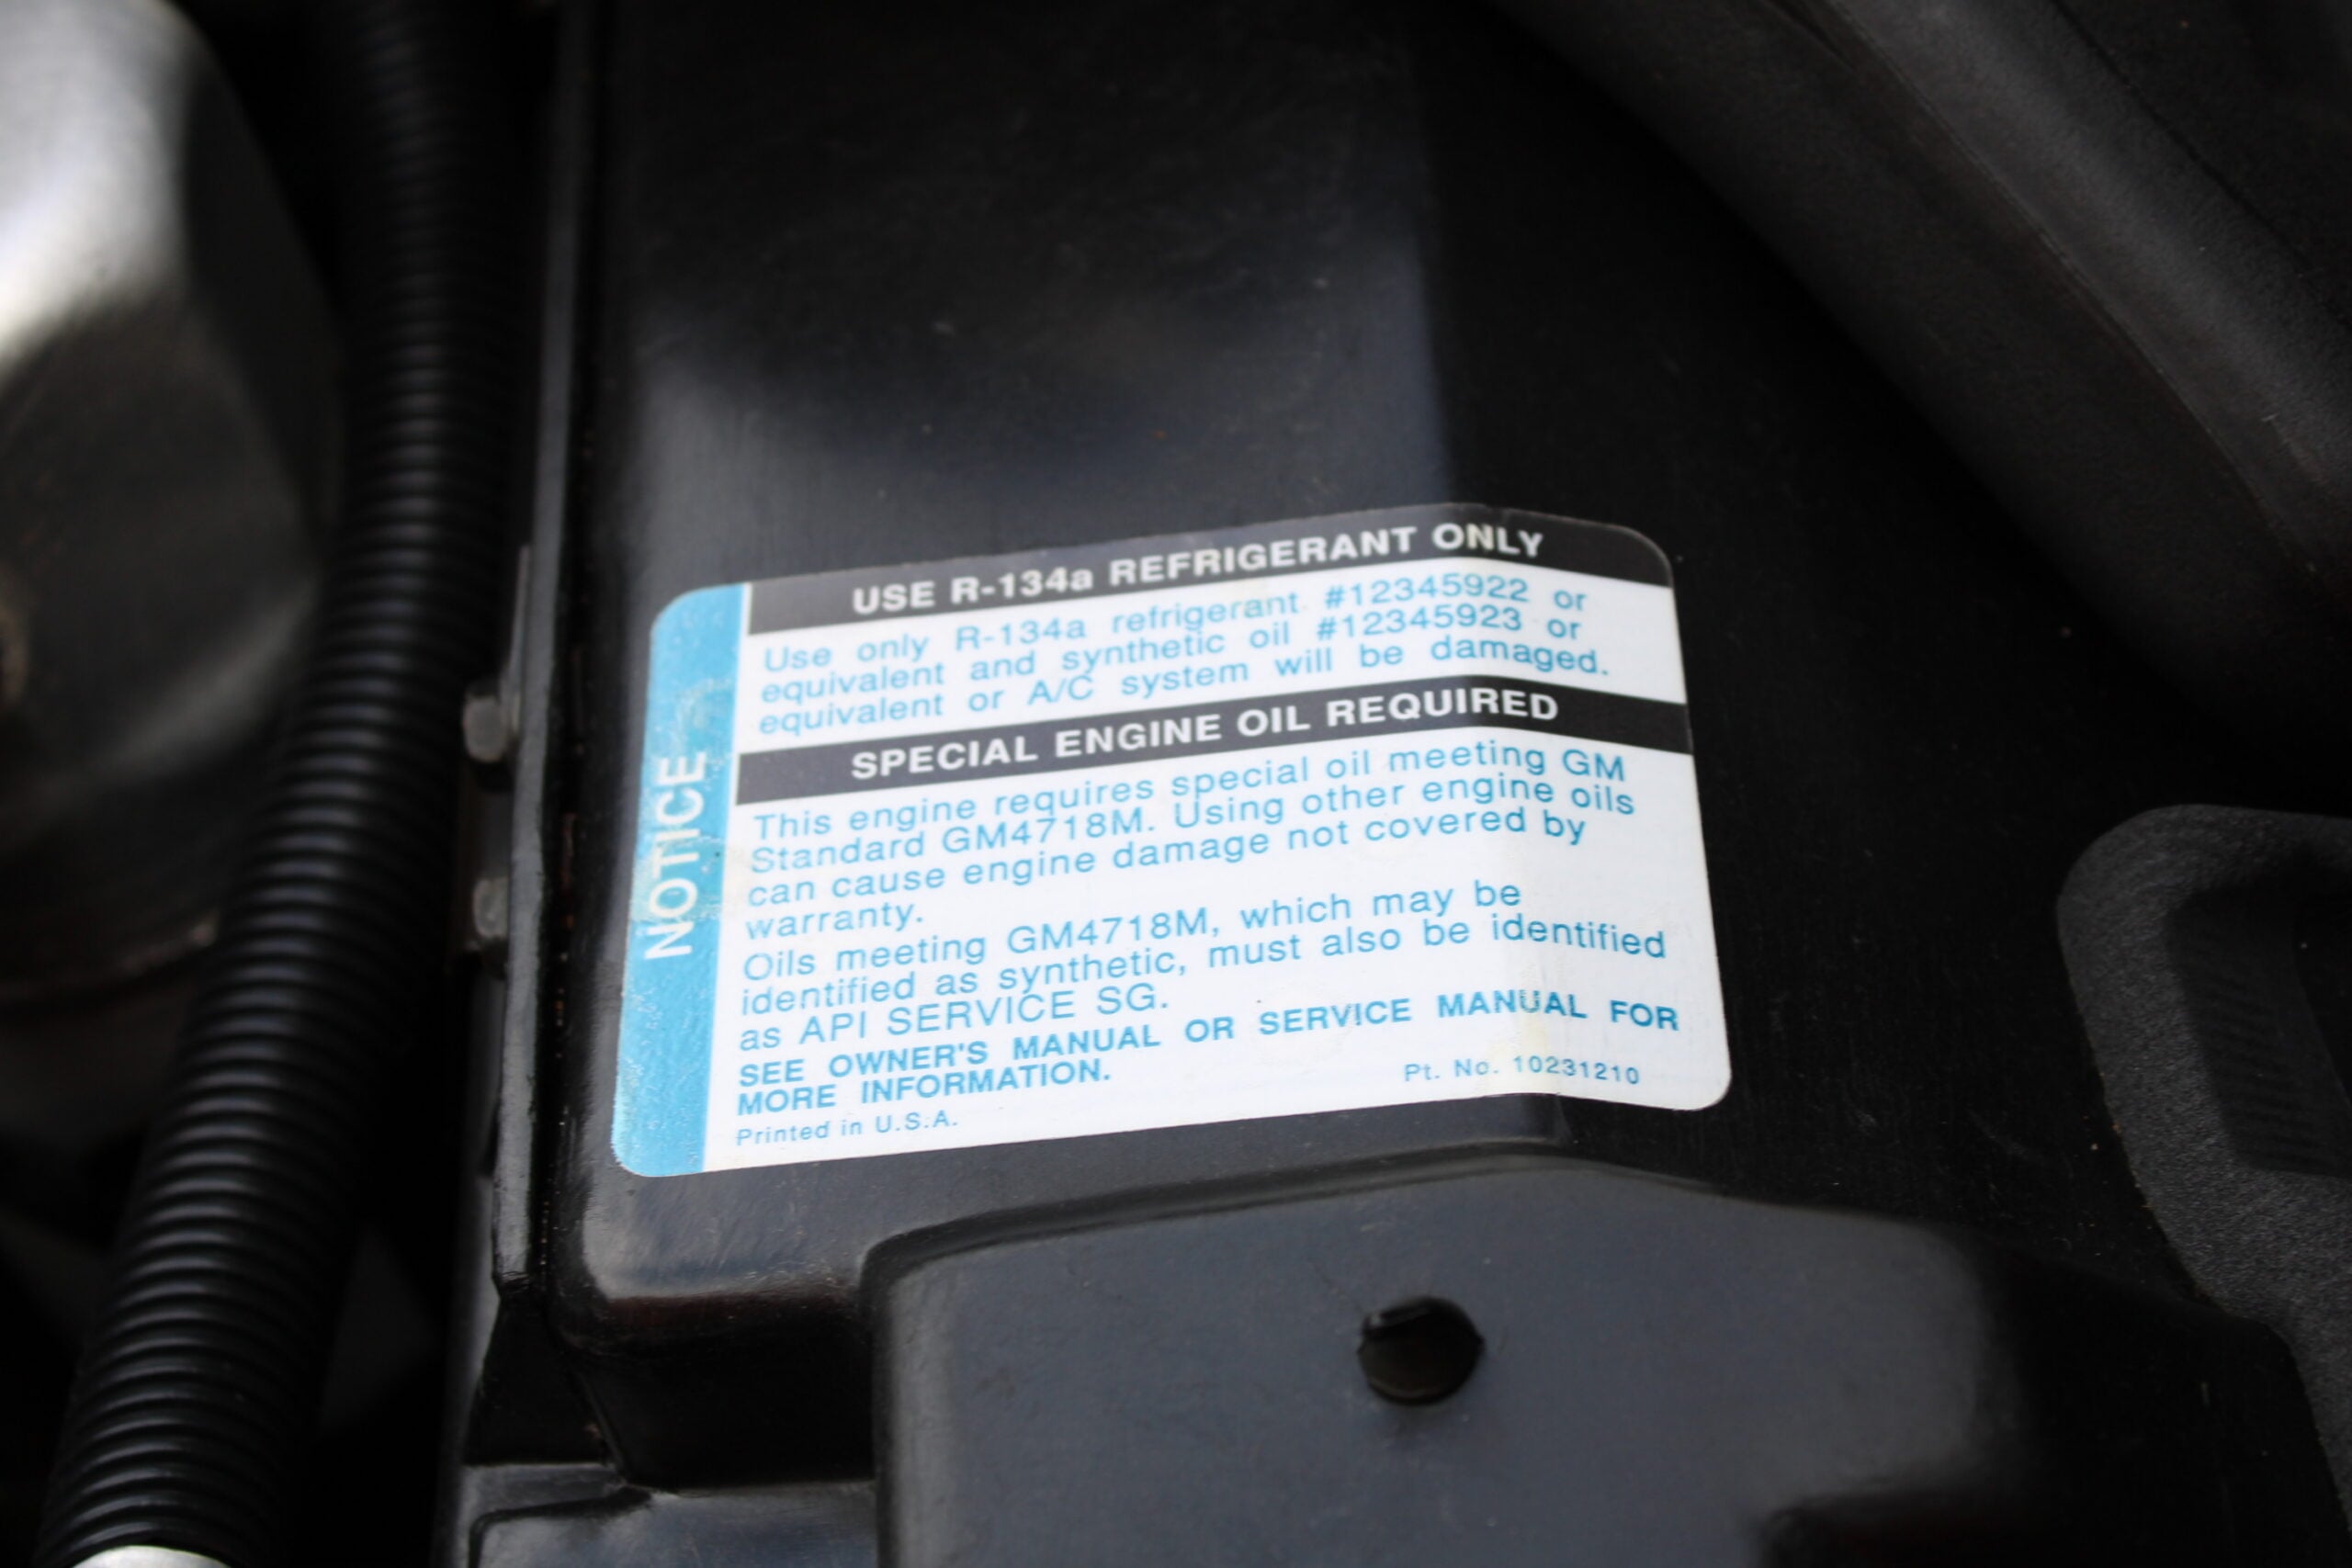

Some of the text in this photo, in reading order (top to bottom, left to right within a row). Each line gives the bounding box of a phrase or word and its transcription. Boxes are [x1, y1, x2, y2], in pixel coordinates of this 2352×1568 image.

[853, 524, 1543, 615] USE R-134a REFRIGERANT ONLY
[762, 603, 1582, 705] equivalent and synthetic oil #12345923 or
[764, 572, 1588, 671] Use only R-134a refrigerant #12345922 or
[759, 635, 1609, 736] equivalent or A/C system will be damaged.
[852, 688, 1558, 780] SPECIAL ENGINE OIL REQUIRED
[751, 772, 1636, 874] Standard GM4718M. Using other engine oils
[753, 739, 1626, 840] This engine requires special oil meeting GM
[644, 751, 707, 959] NOTICE
[748, 806, 1587, 907] can cause engine damage not covered by
[742, 912, 1667, 1015] identified as synthetic, must also be identified
[743, 879, 1521, 981] Oils meeting GM4718M, which may be
[746, 902, 923, 940] warranty.
[739, 989, 1679, 1088] SEE OWNER'S MANUAL OR SERVICE MANUAL FOR
[740, 982, 1169, 1051] as API SERVICE SG.
[737, 1058, 1111, 1116] MORE INFORMATION.
[1404, 1055, 1640, 1085] Pt. No. 10231210
[737, 1110, 958, 1145] Printed in U.S.A.
